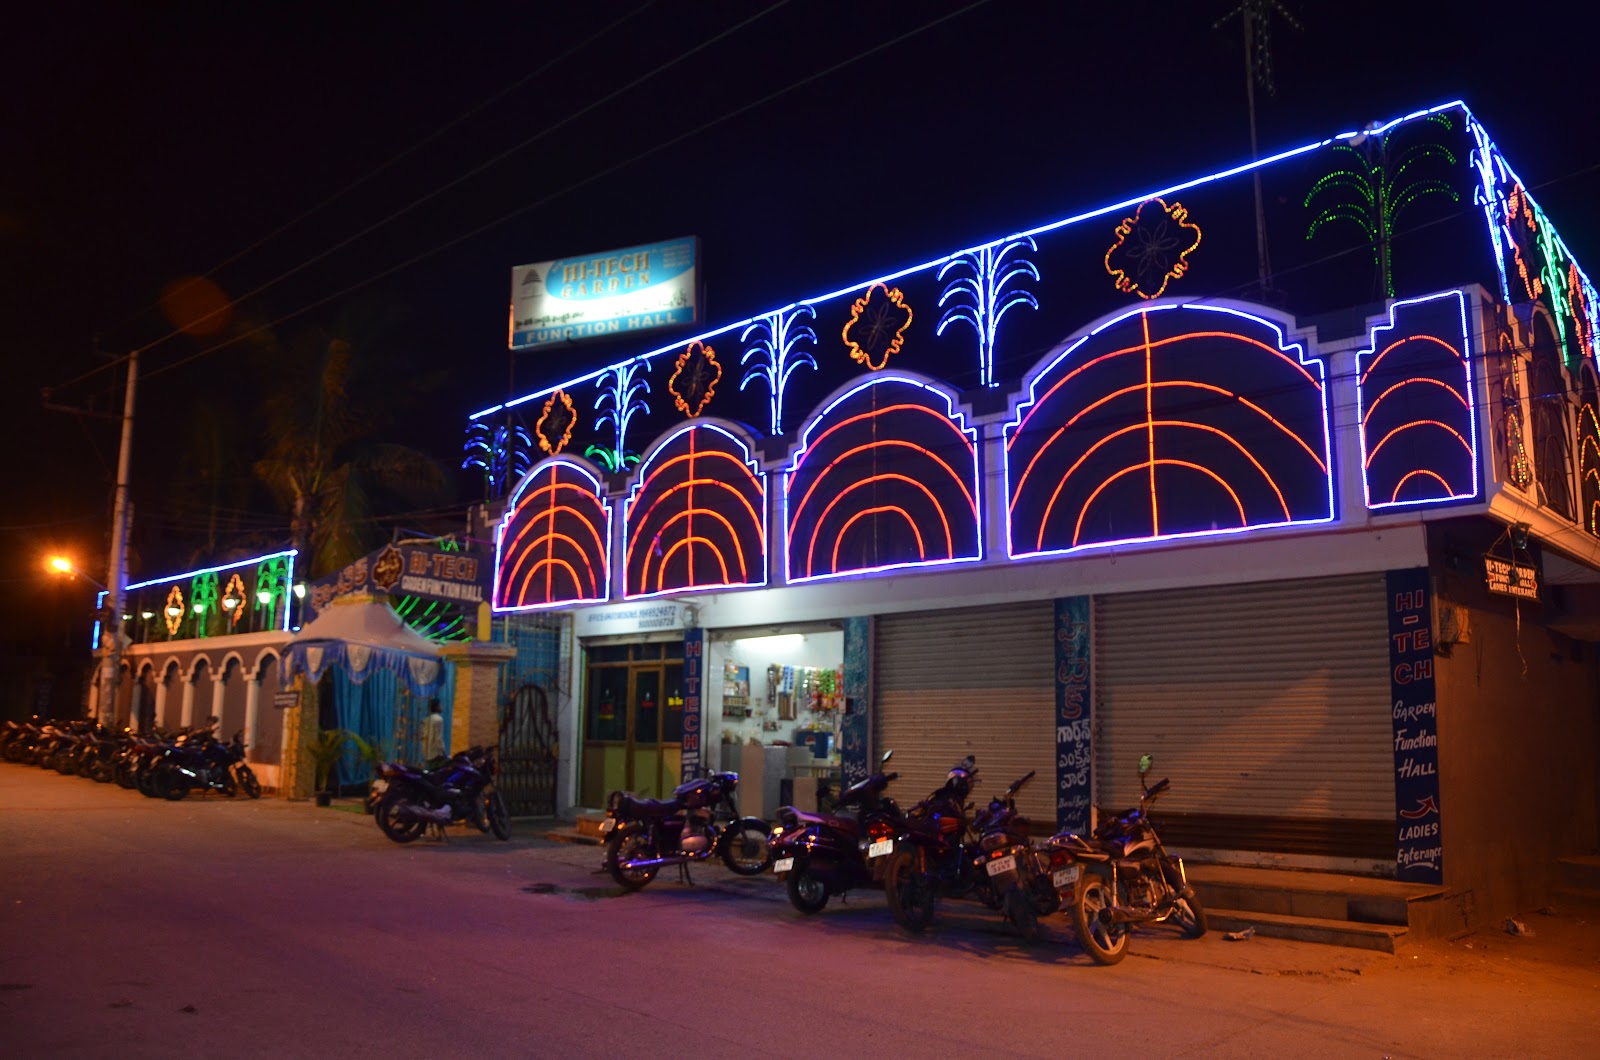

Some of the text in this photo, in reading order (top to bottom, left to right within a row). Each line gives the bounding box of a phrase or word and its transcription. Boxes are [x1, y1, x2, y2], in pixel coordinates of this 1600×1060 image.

[563, 251, 650, 283] HI-TECH
[561, 273, 650, 298] GARDEN
[527, 319, 620, 343] FUNCTION
[628, 312, 678, 329] HALL
[410, 551, 478, 581] HI-TECH
[1393, 700, 1436, 721] GARDEN
[1395, 728, 1437, 751] Function
[1398, 758, 1436, 779] HALL
[1399, 822, 1439, 841] LADIES
